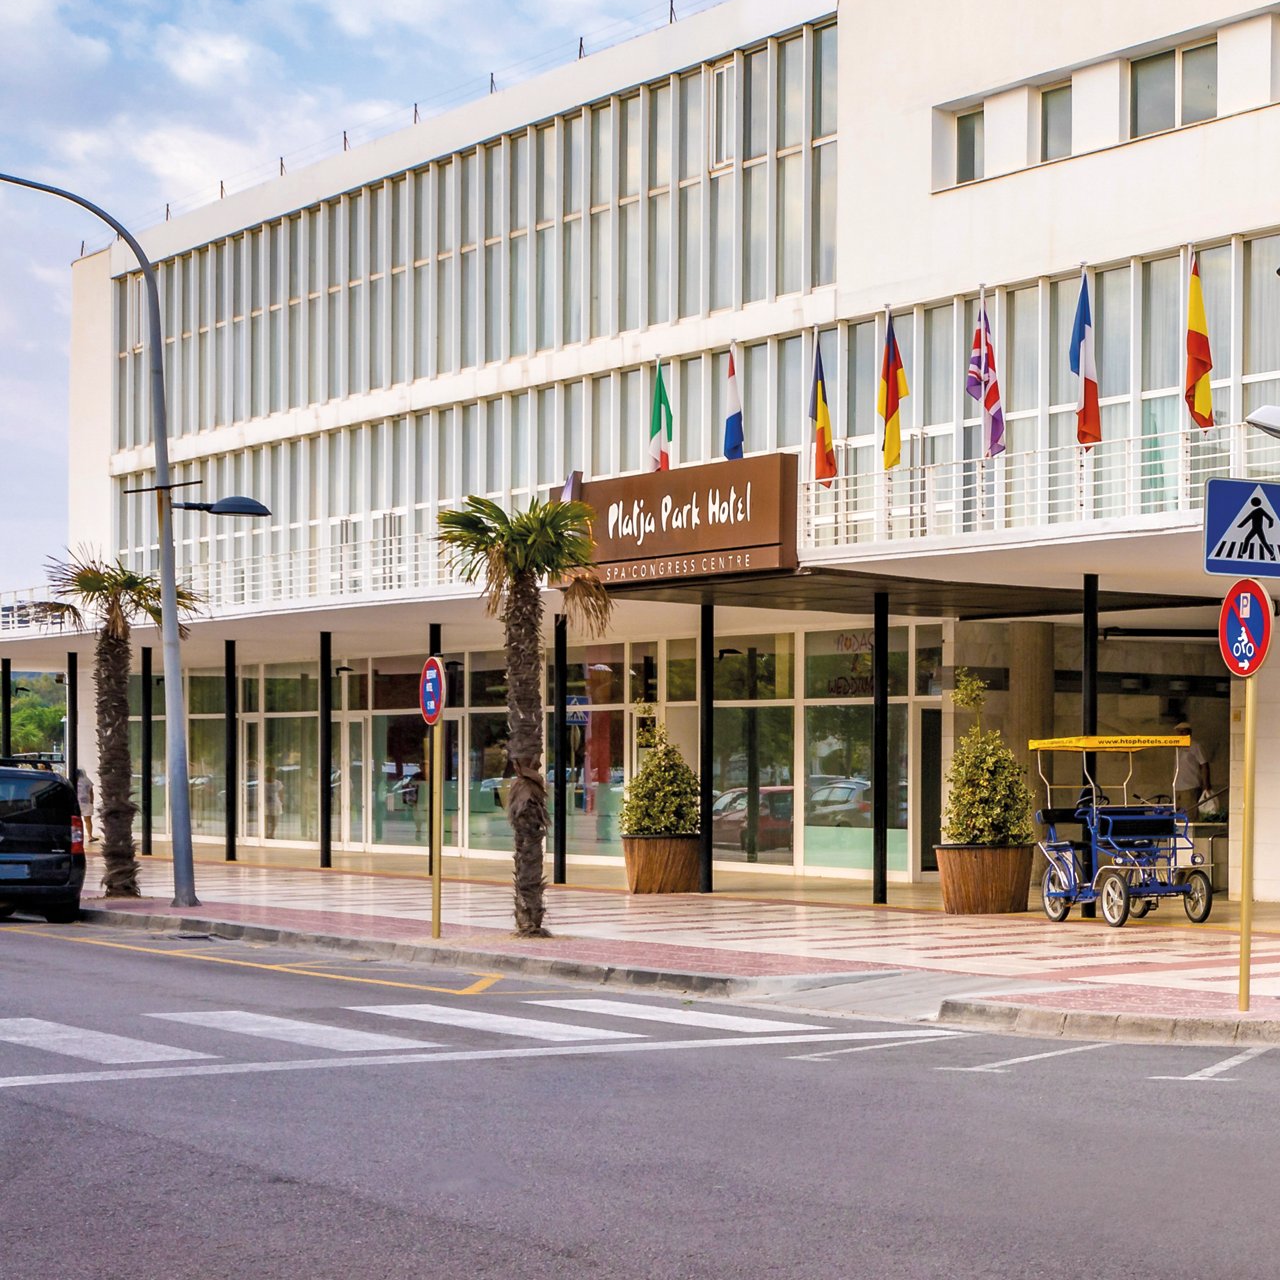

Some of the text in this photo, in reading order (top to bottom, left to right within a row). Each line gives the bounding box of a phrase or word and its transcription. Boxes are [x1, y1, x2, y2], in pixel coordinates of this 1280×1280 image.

[608, 481, 751, 546] Platja Park Hotel
[701, 554, 750, 572] CENTRE
